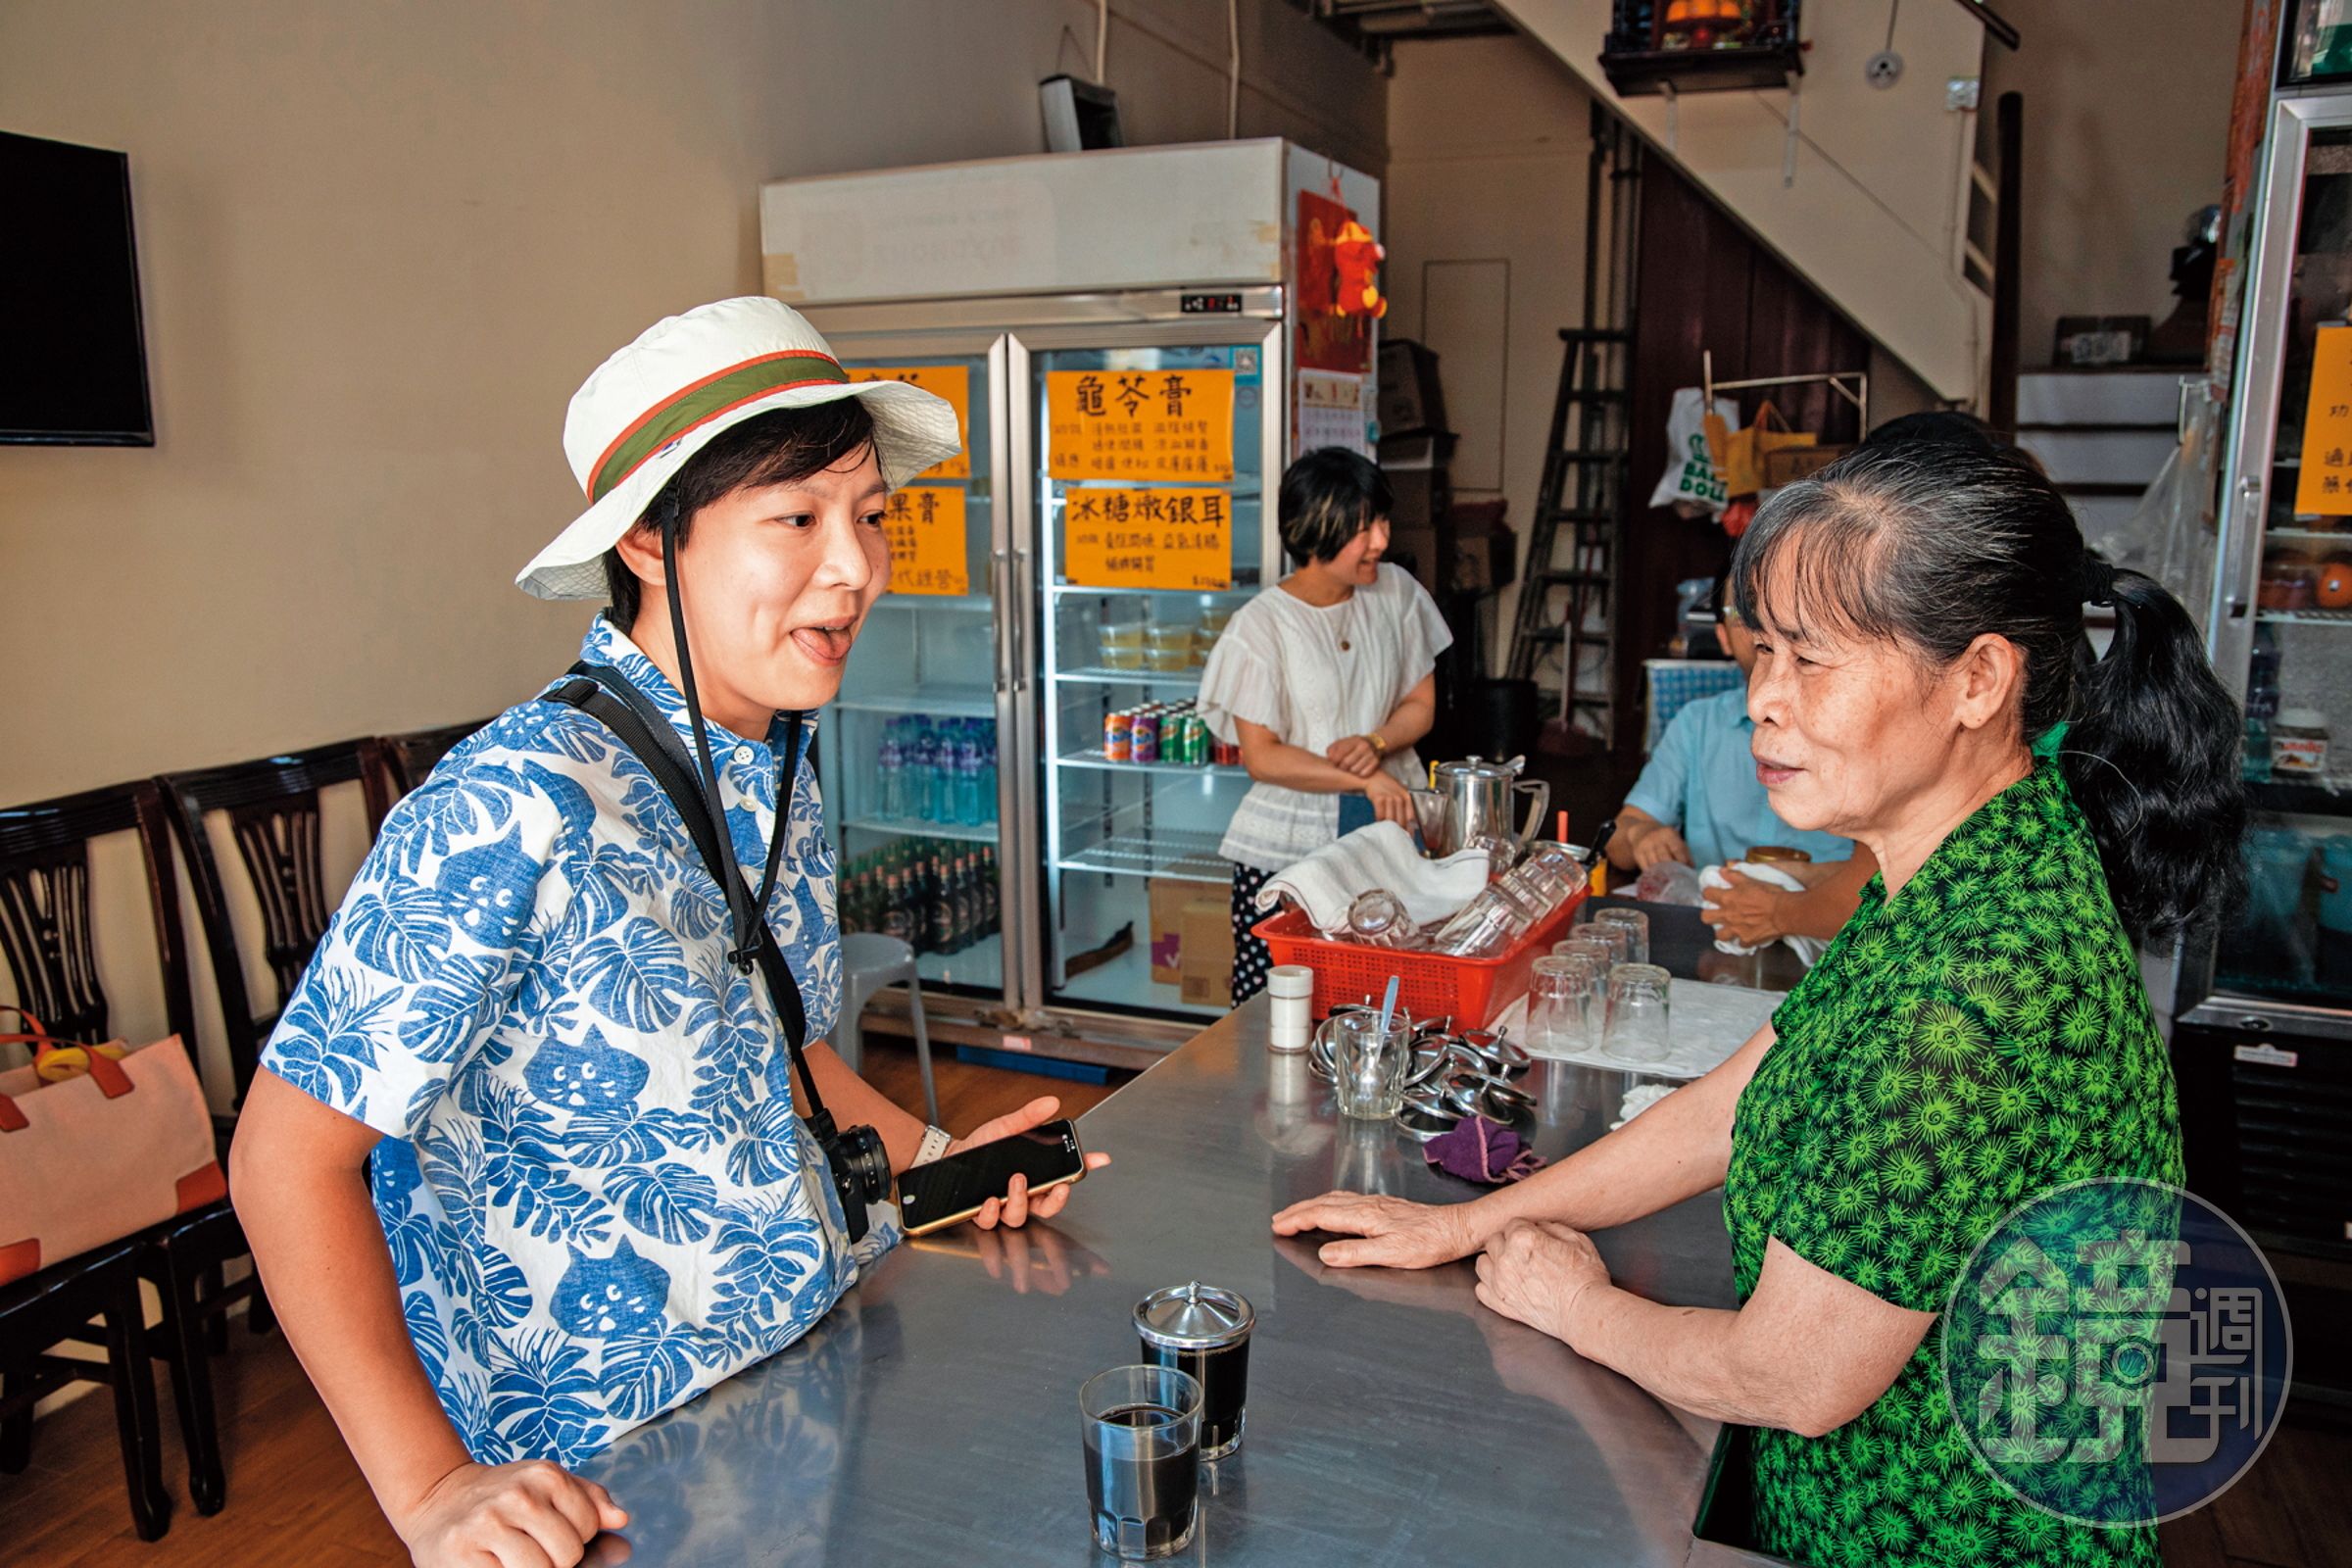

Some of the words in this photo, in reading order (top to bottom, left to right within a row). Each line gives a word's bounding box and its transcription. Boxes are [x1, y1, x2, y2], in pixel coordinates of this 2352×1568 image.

[1076, 374, 1193, 417] 龜苓膏
[1071, 493, 1224, 527] 冰糖燉銀耳
